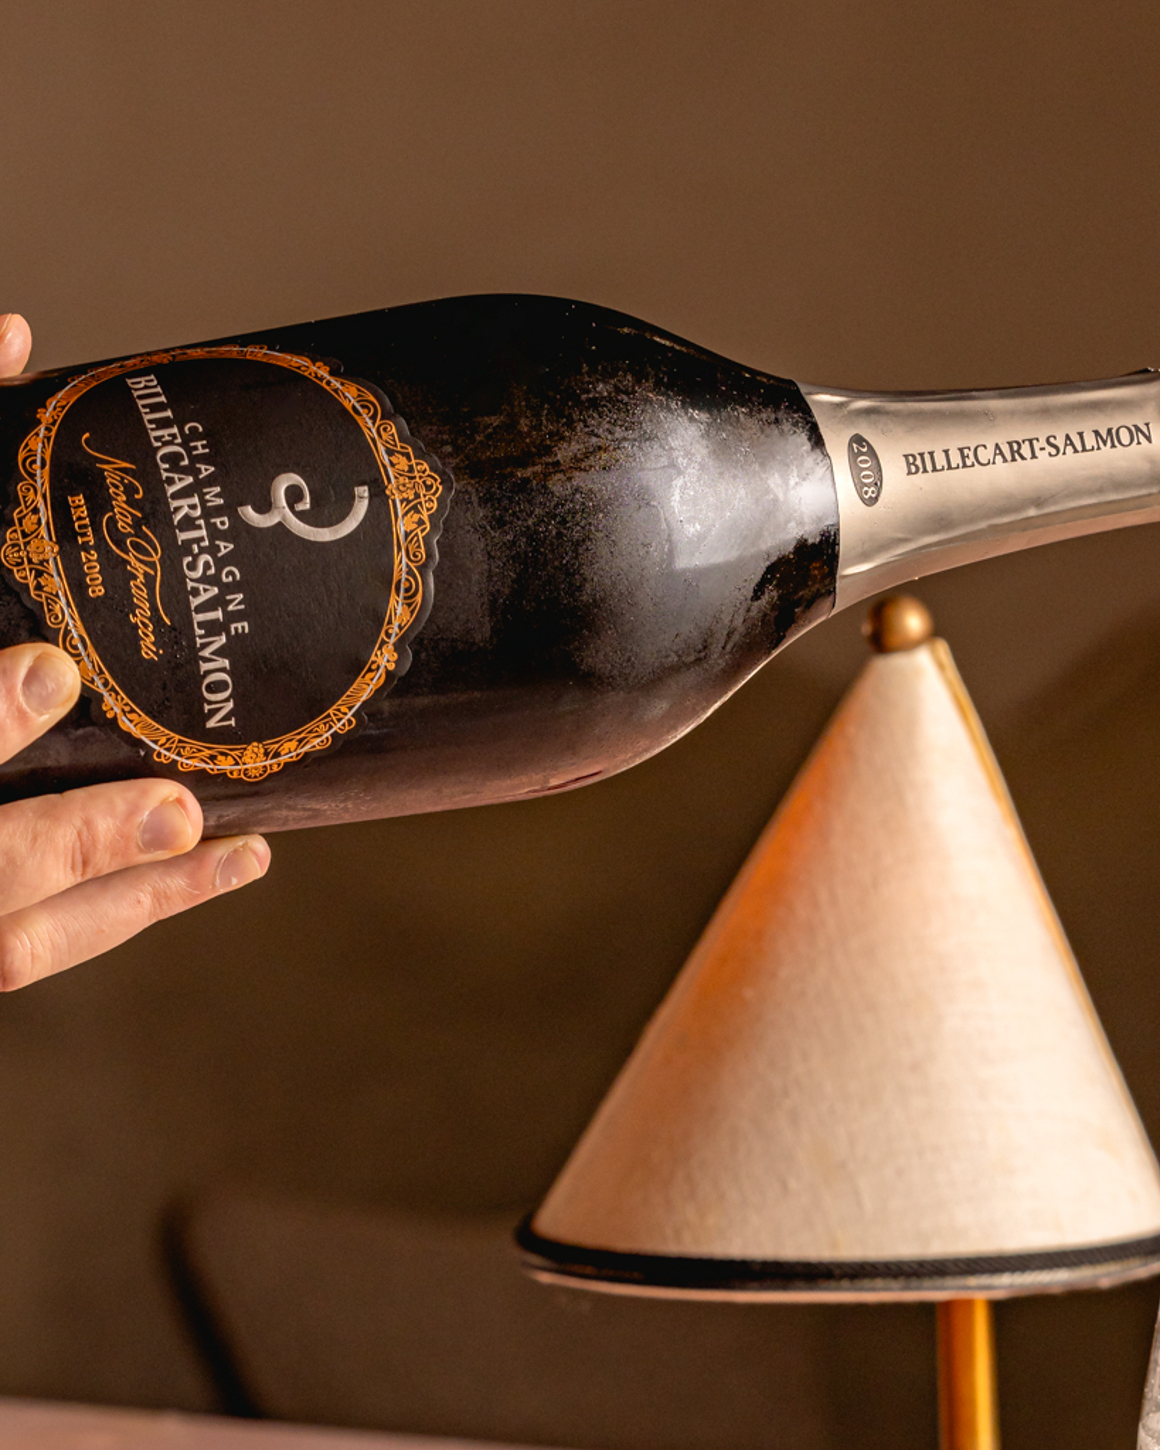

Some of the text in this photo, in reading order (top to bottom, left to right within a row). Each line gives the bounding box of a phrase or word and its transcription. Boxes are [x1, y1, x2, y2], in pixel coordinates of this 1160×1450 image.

[184, 422, 249, 635] CHAMPAGNE
[852, 441, 877, 500] 2008
[904, 423, 1153, 476] BILLECART-SALMON
[69, 494, 105, 597] BRUT 2008
[81, 433, 171, 660] Nicolas François
[125, 374, 235, 729] BILLECART-SALMON
